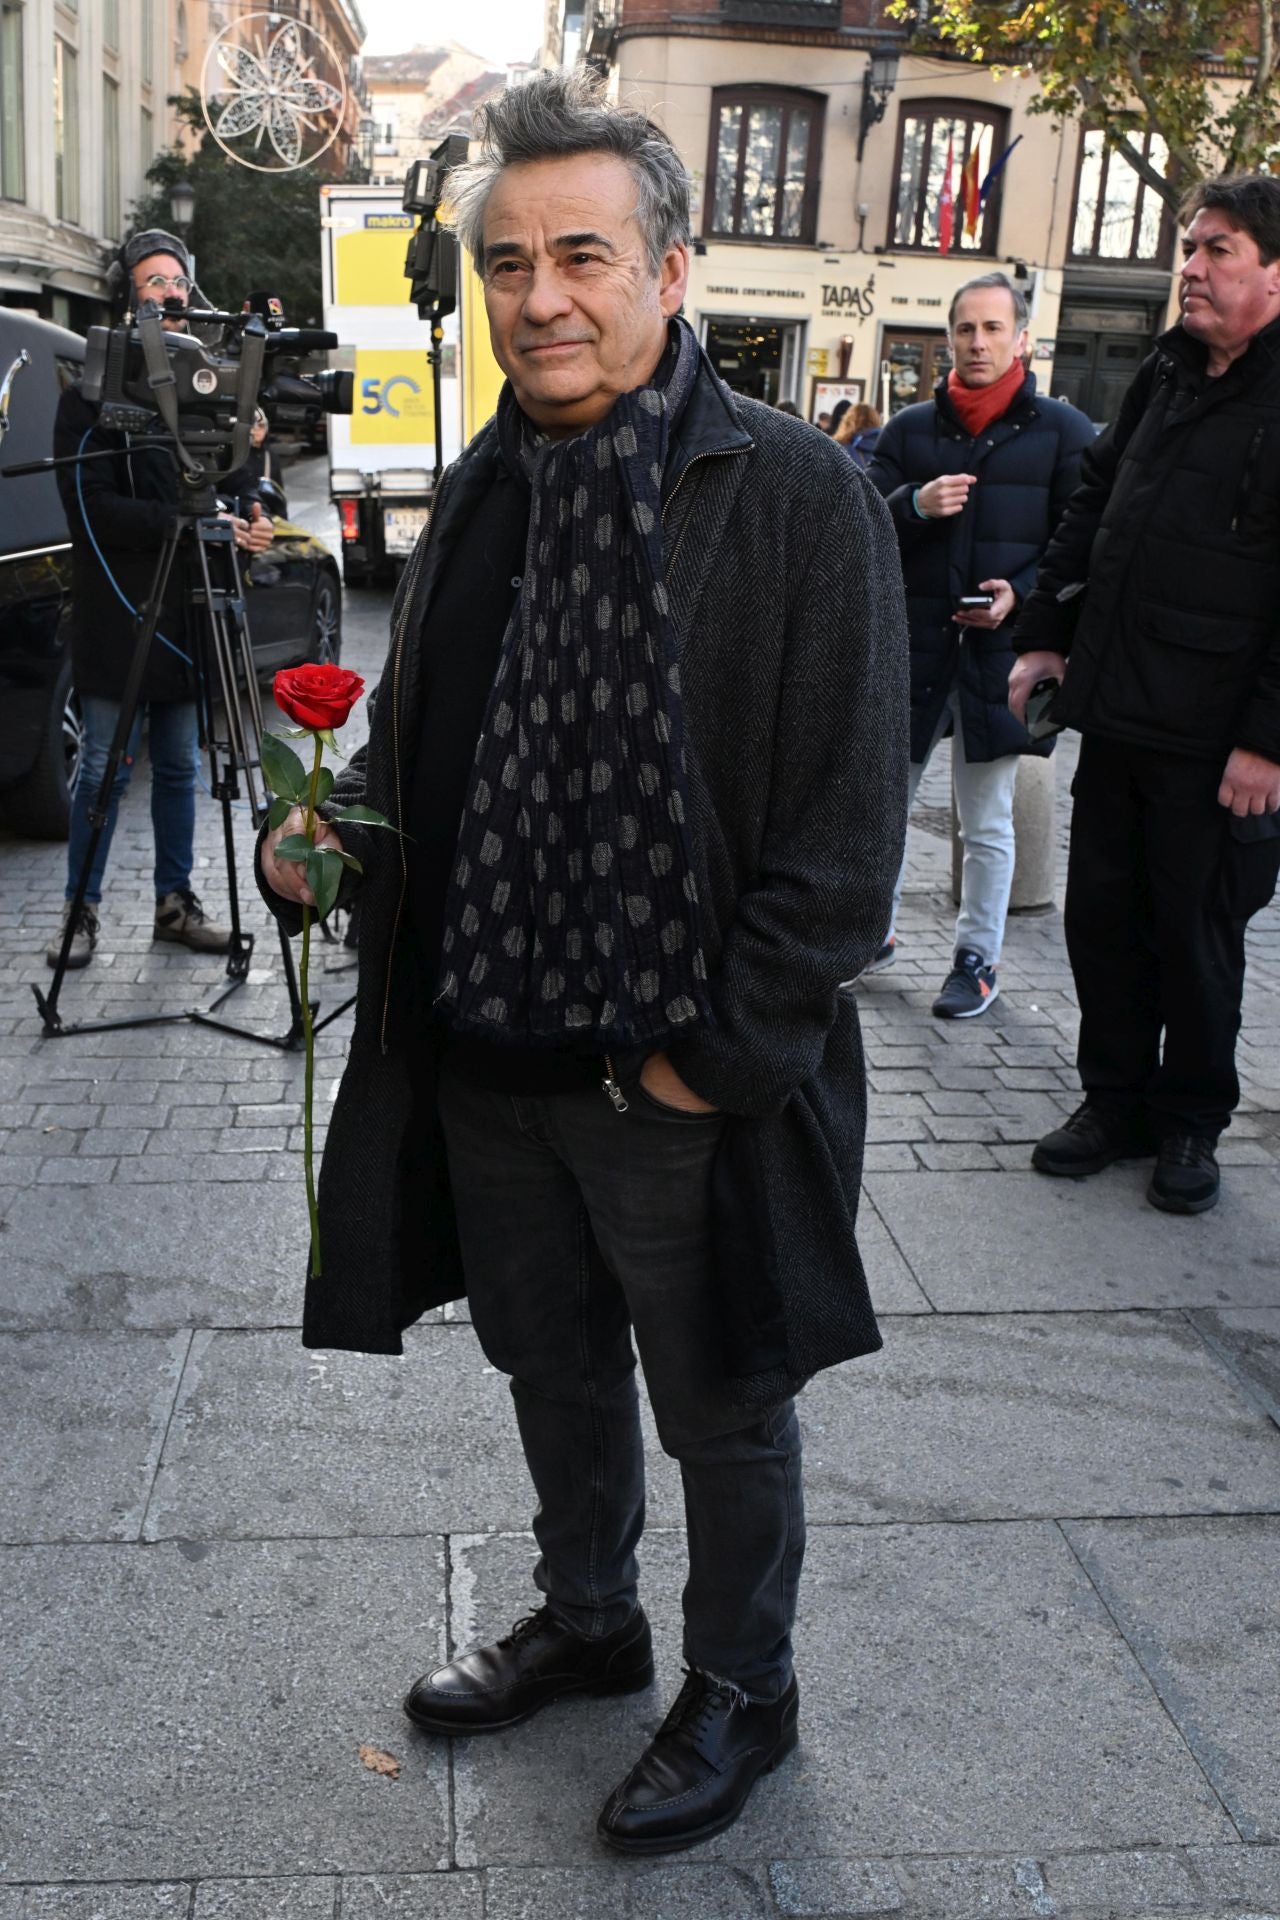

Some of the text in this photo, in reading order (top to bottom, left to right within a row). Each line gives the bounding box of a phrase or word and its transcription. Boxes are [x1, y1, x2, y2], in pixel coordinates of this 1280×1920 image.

[368, 215, 411, 228] makro
[706, 285, 805, 299] TABERNA CONTEMPORÁNEA
[821, 283, 875, 317] TAPAS
[891, 296, 909, 305] VINO
[821, 309, 858, 318] SANTA ANA
